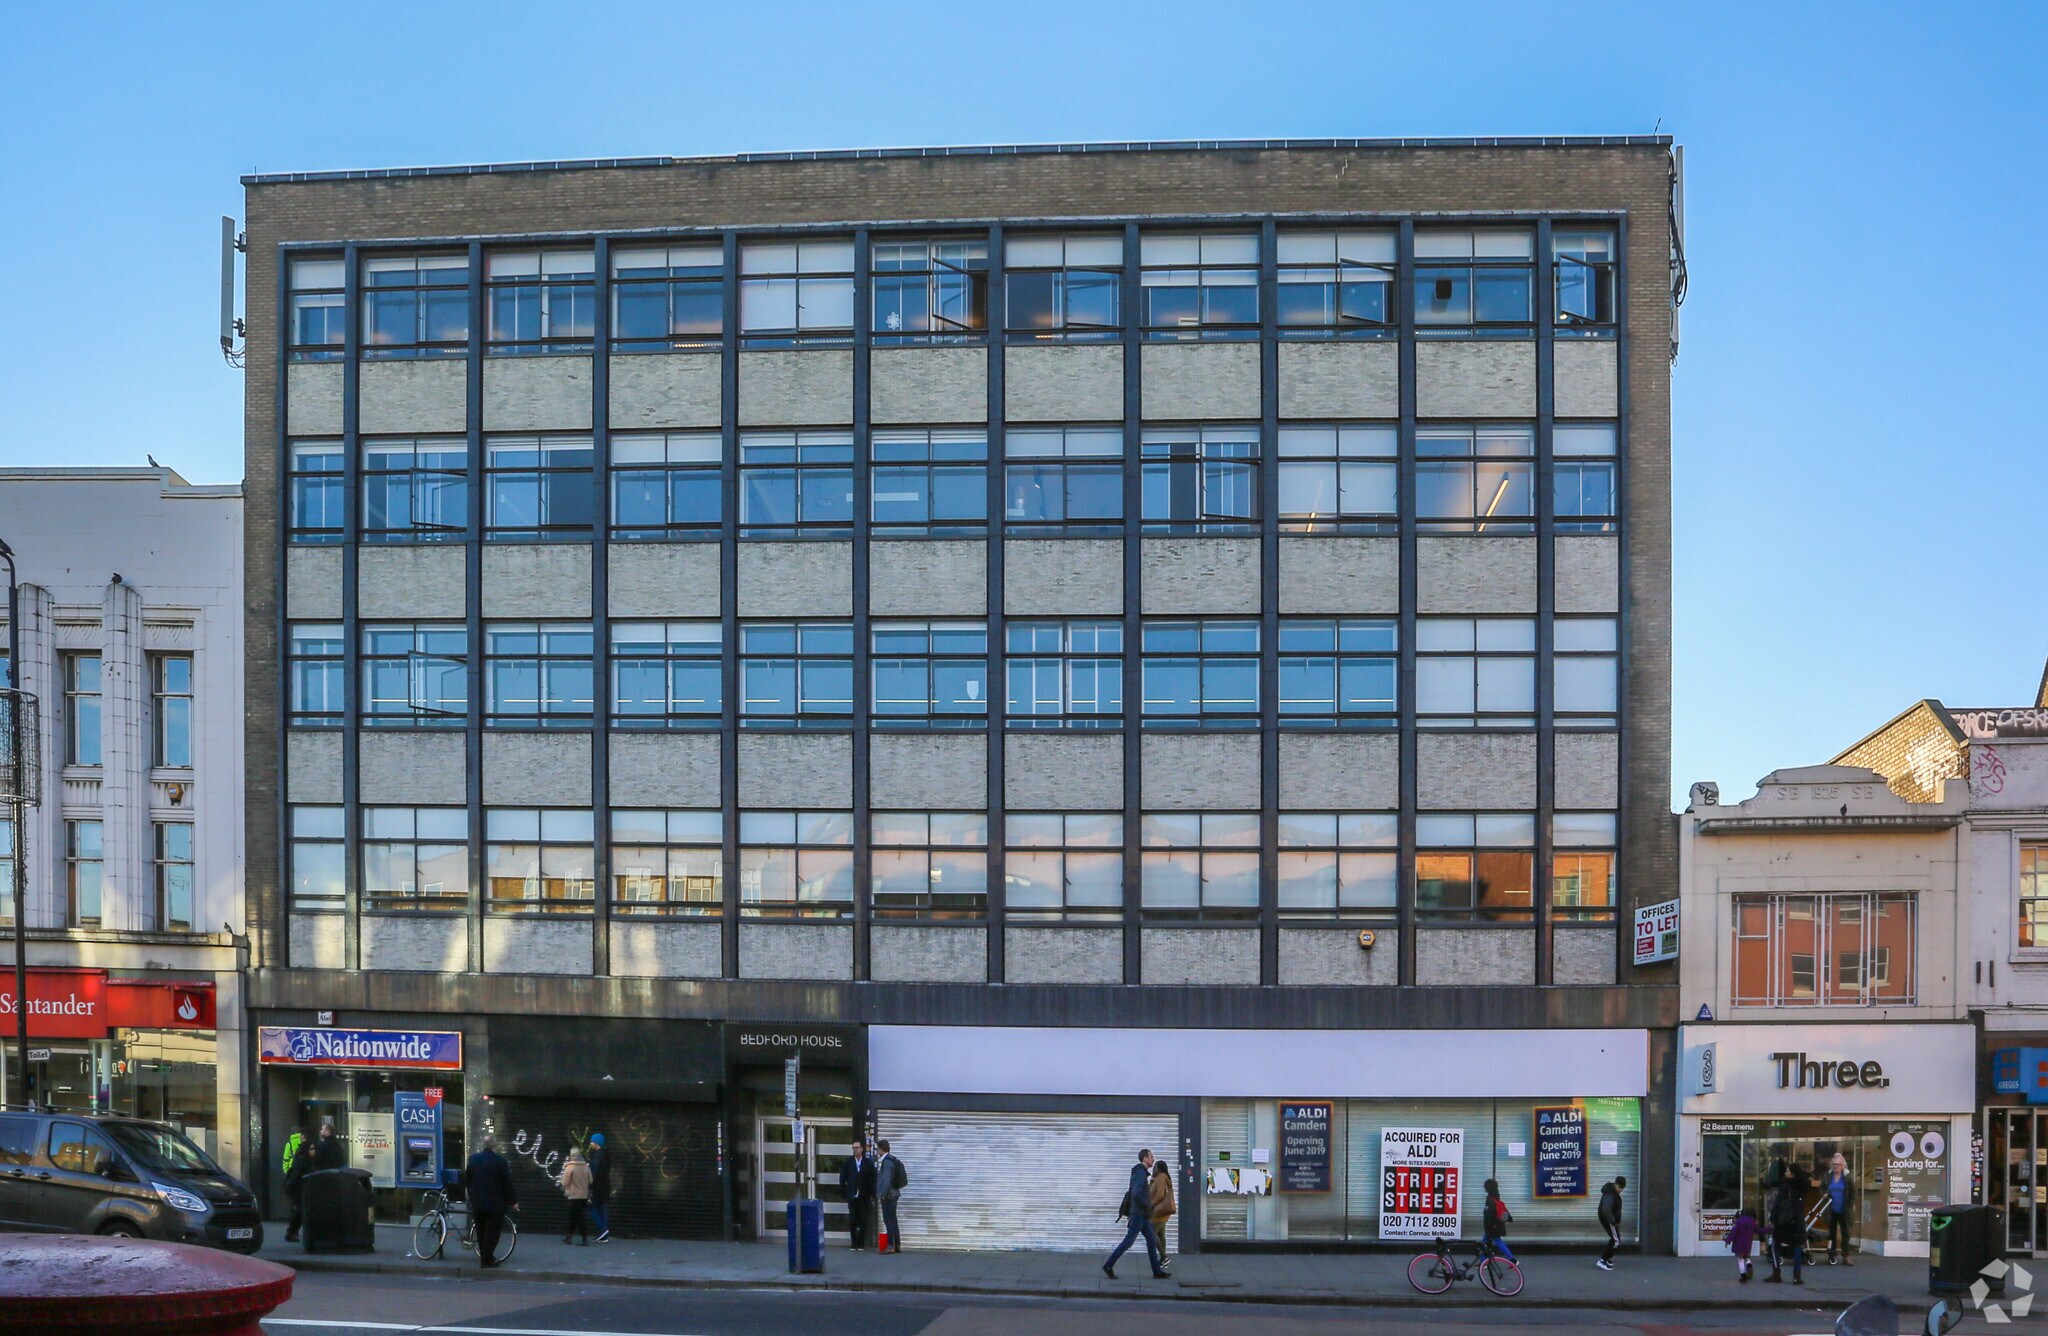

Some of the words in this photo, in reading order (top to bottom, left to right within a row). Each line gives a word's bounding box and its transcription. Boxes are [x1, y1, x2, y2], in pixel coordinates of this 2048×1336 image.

[1811, 787, 1840, 800] 1925
[1641, 903, 1675, 919] OFFICES
[1637, 921, 1653, 936] TO
[1657, 914, 1678, 932] LET
[0, 993, 95, 1016] Santander
[316, 1033, 431, 1059] Nationwide
[740, 1034, 798, 1046] BEDFORD
[801, 1035, 842, 1047] HOUSE
[29, 1051, 49, 1059] Toilet
[424, 1088, 442, 1098] FREE
[401, 1108, 435, 1123] CASH
[1297, 1108, 1327, 1118] ALDI
[1553, 1112, 1582, 1123] ALDI
[1284, 1120, 1327, 1130] Camden
[1540, 1124, 1582, 1135] Camden
[1287, 1136, 1324, 1147] Opening
[1384, 1132, 1437, 1143] ACQUIRED
[1439, 1133, 1460, 1143] FOR
[1284, 1147, 1304, 1156] June
[1306, 1146, 1326, 1155] 2019
[1407, 1145, 1437, 1158] ALDI
[1542, 1140, 1579, 1152] Opening
[1539, 1151, 1560, 1161] June
[1561, 1151, 1582, 1159] 2019
[1887, 1159, 1923, 1170] Looking
[1925, 1159, 1945, 1168] for...
[1385, 1172, 1456, 1189] STRIPE
[1384, 1192, 1456, 1209] STREET
[1383, 1216, 1402, 1227] 020
[1404, 1216, 1429, 1227] 7112
[1432, 1217, 1457, 1228] 8909
